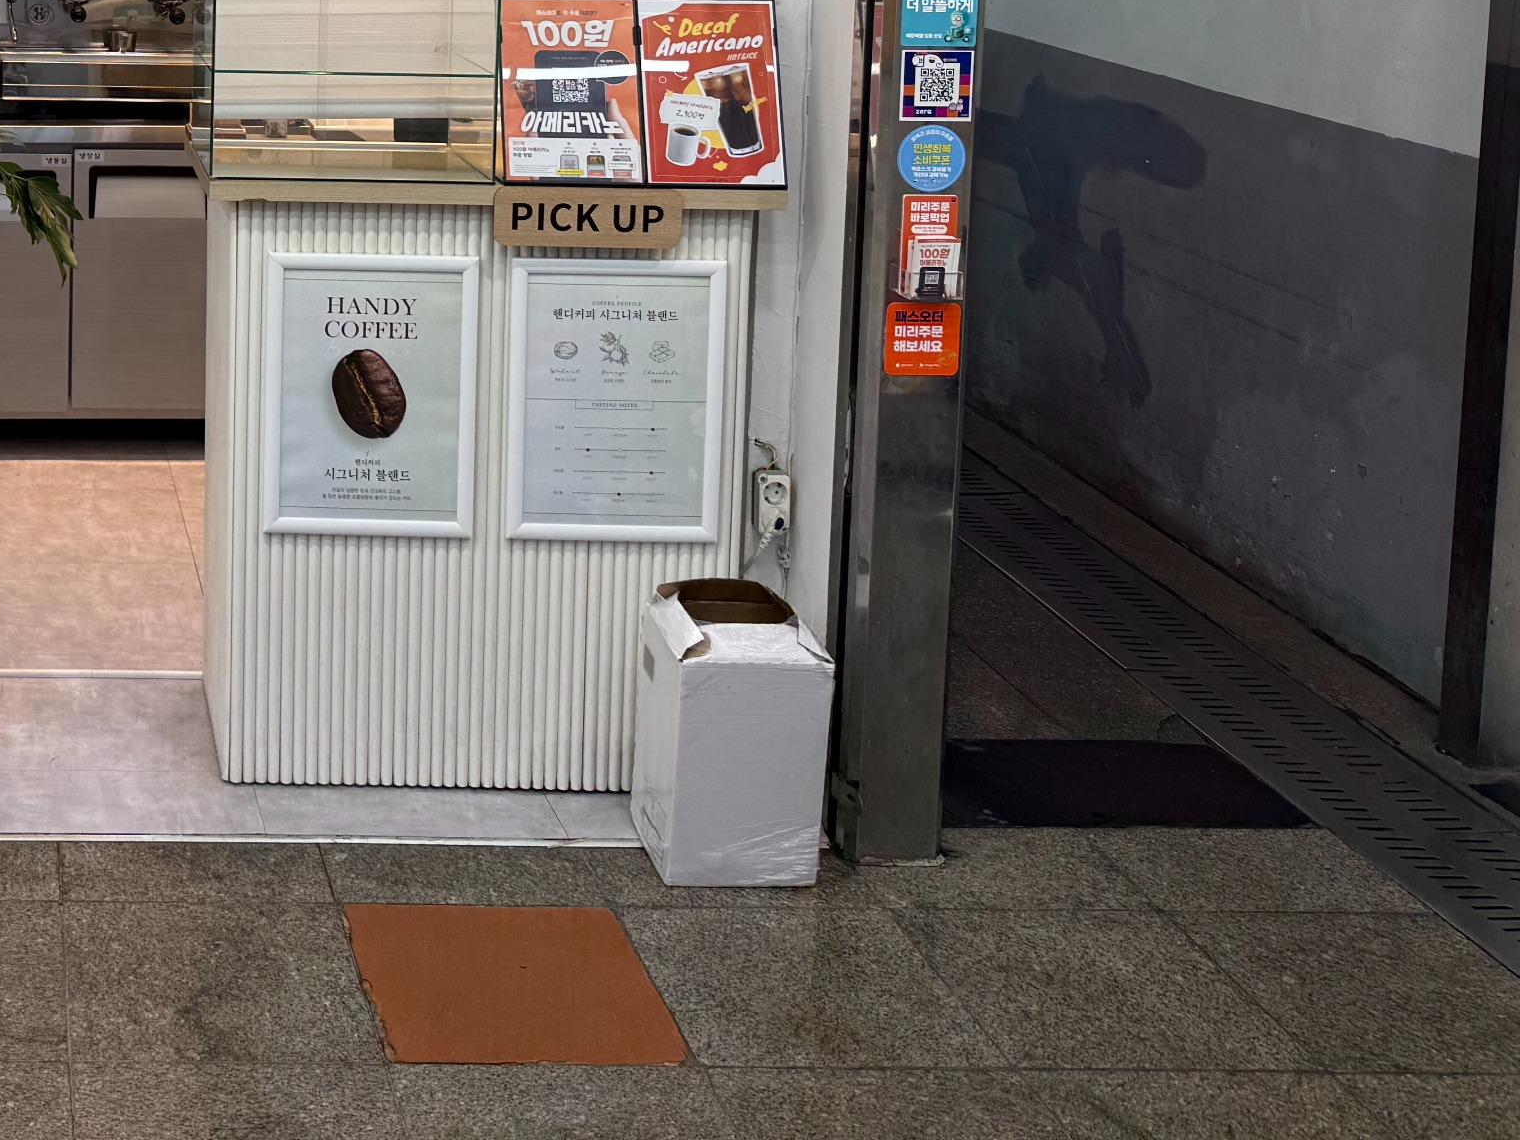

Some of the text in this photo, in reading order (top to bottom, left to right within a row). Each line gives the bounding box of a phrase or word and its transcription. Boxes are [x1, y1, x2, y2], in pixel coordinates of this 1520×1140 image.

[678, 13, 739, 37] Decaf
[521, 20, 614, 47] 100원
[656, 34, 763, 57] Americano
[521, 111, 624, 134] 아메리카노
[911, 202, 950, 212] 미리주문
[512, 203, 664, 233] PICK UP
[910, 213, 949, 222] 바로픽업
[920, 249, 950, 258] 100원
[327, 297, 418, 316] HANDY
[553, 308, 595, 320] 핸디커피
[600, 309, 642, 320] 시그니처
[895, 311, 944, 323] 패스오더
[324, 321, 418, 340] COFFEE
[895, 326, 944, 338] 미리주문
[893, 340, 943, 352] 해보세요
[325, 468, 370, 480] 시그니처
